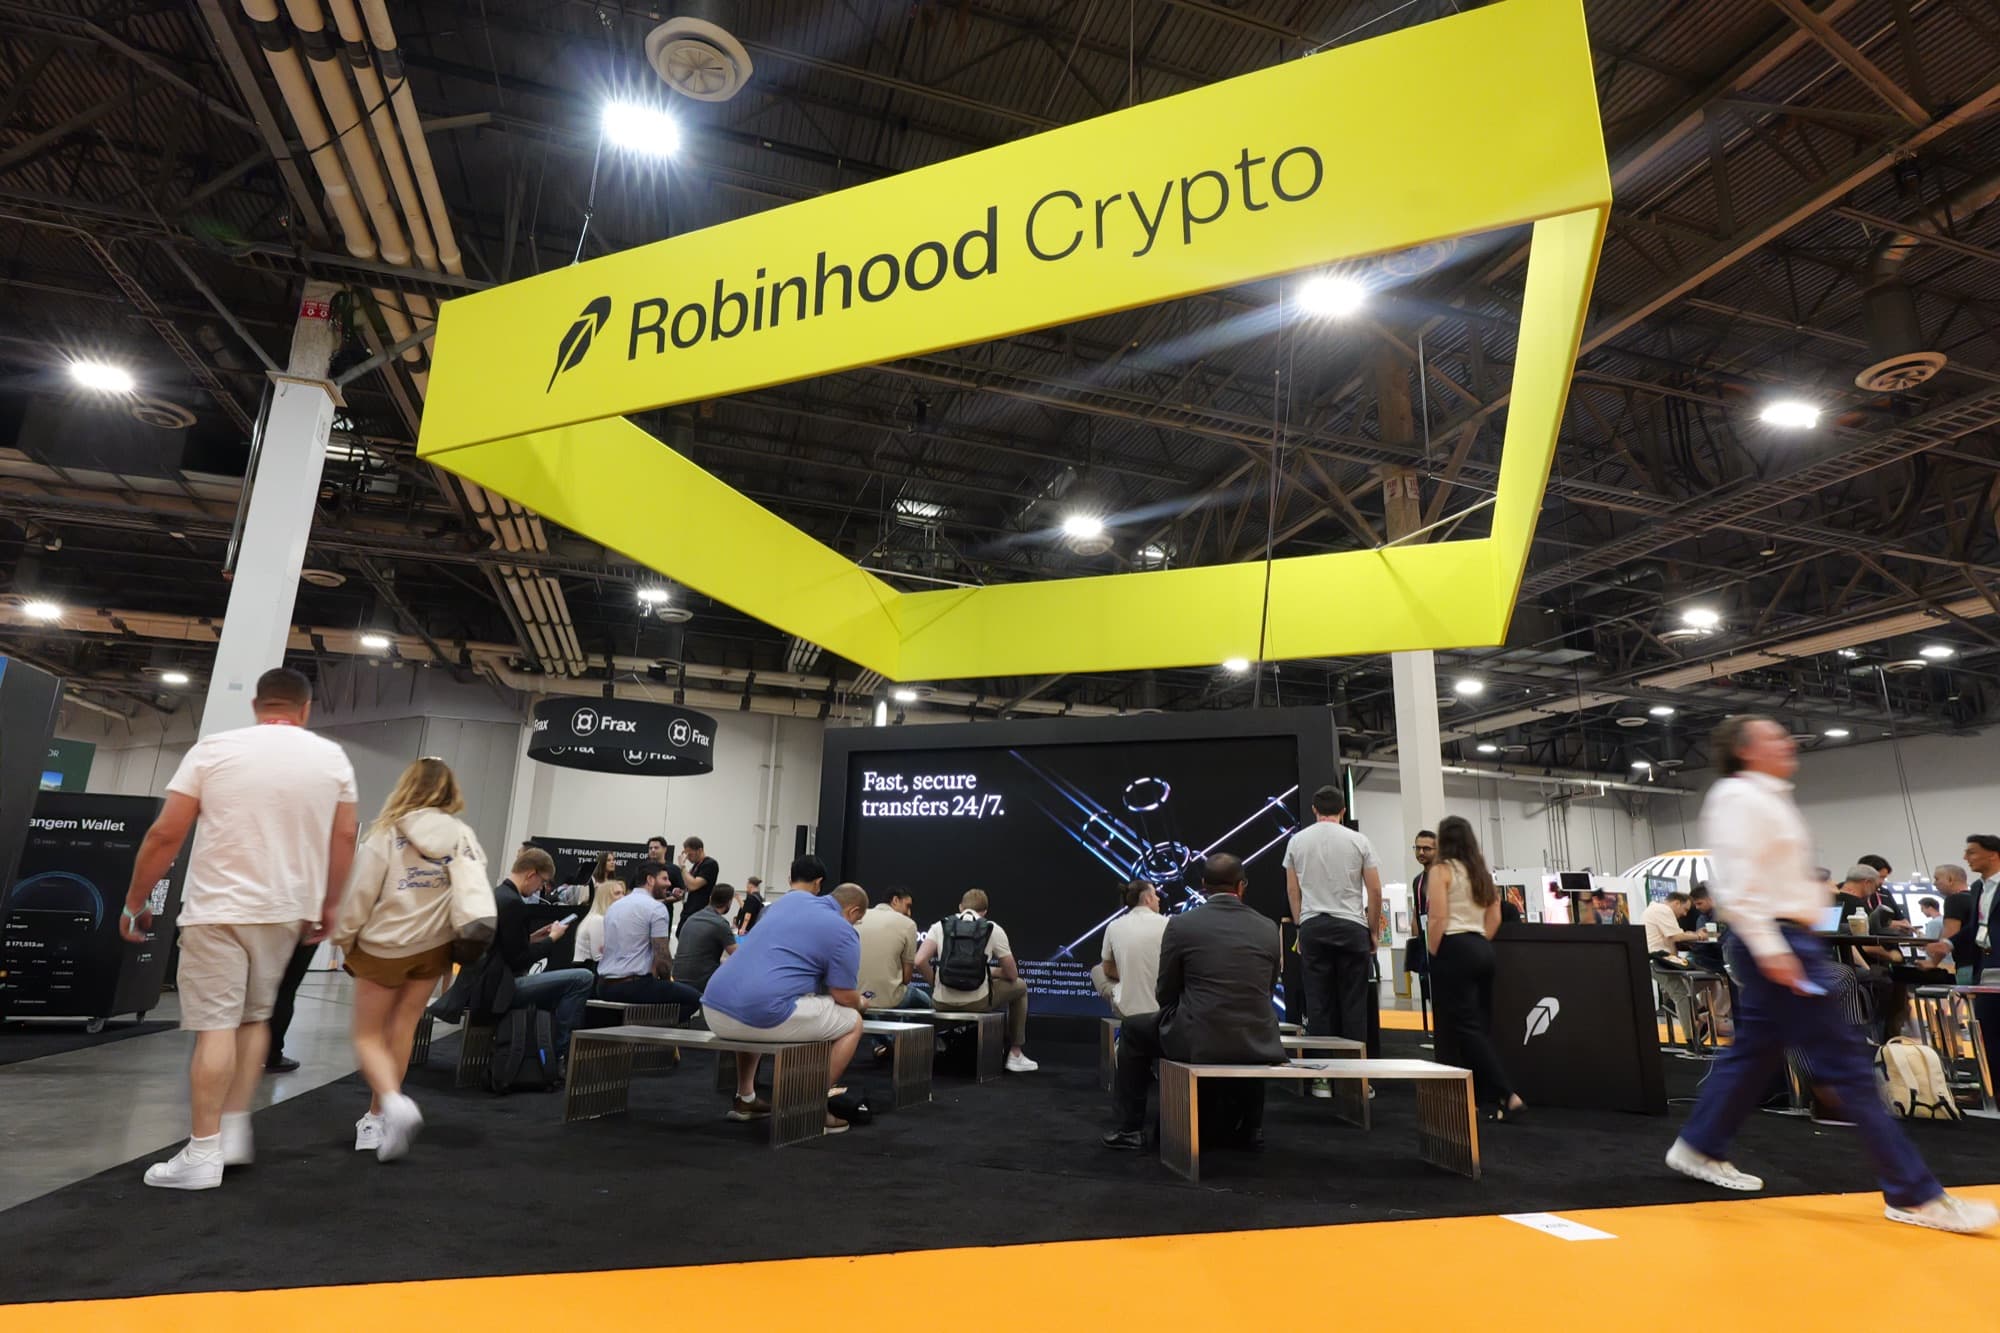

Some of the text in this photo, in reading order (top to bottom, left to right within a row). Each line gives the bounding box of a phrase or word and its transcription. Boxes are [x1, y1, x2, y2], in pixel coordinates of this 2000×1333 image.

[628, 147, 1323, 360] Robinhood Crypto
[601, 716, 637, 733] Frax
[691, 729, 710, 747] Frax
[862, 771, 977, 794] Fast, secure
[861, 793, 1005, 819] transfers 24/7.
[29, 818, 126, 832] angem Wallet
[558, 847, 572, 855] THE
[573, 849, 608, 857] FINANC
[1052, 979, 1085, 987] Department
